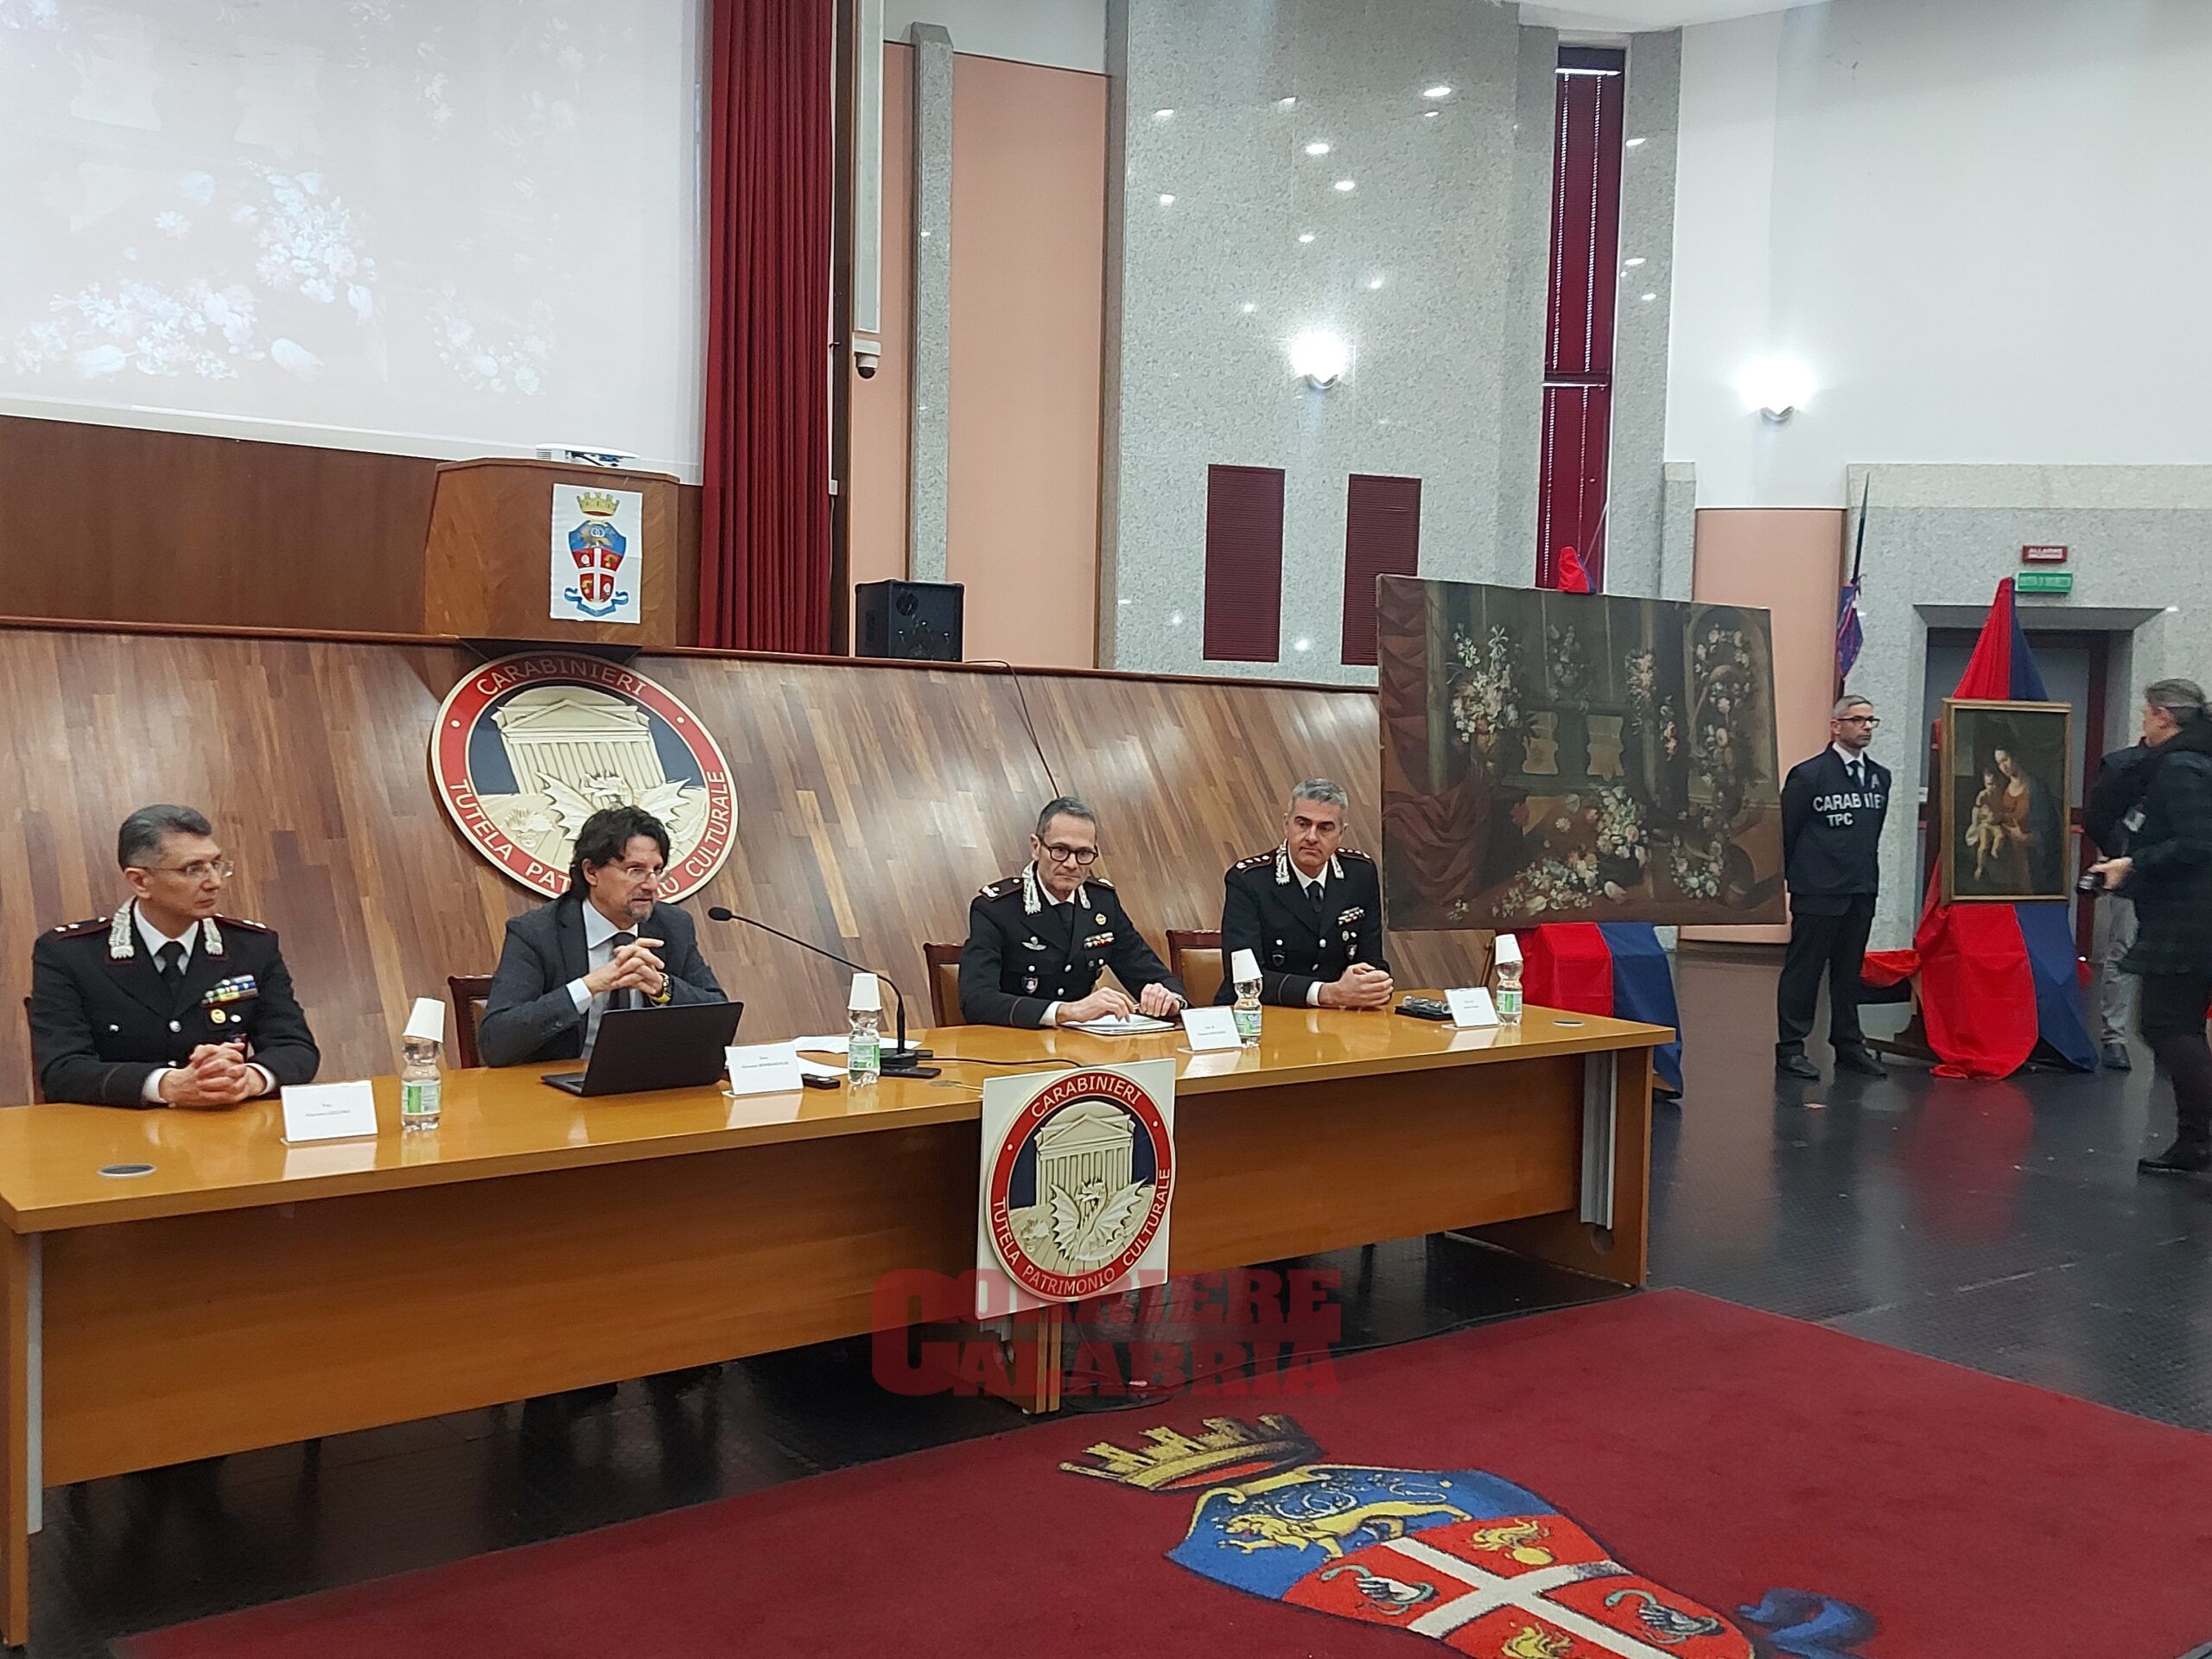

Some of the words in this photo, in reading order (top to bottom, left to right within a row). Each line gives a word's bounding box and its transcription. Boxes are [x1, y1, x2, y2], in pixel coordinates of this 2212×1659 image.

[476, 658, 647, 696] CARABINIERI
[450, 779, 512, 862] TUTELA
[524, 861, 680, 898] PATIO
[685, 770, 732, 877] CULTURALE
[1826, 812, 1853, 827] TPC
[1031, 1076, 1142, 1118] CARABINIERI
[993, 1196, 1021, 1266] TUTELA
[1021, 1264, 1116, 1295] PATRIMONIO
[1123, 1168, 1171, 1267] CULTURALE
